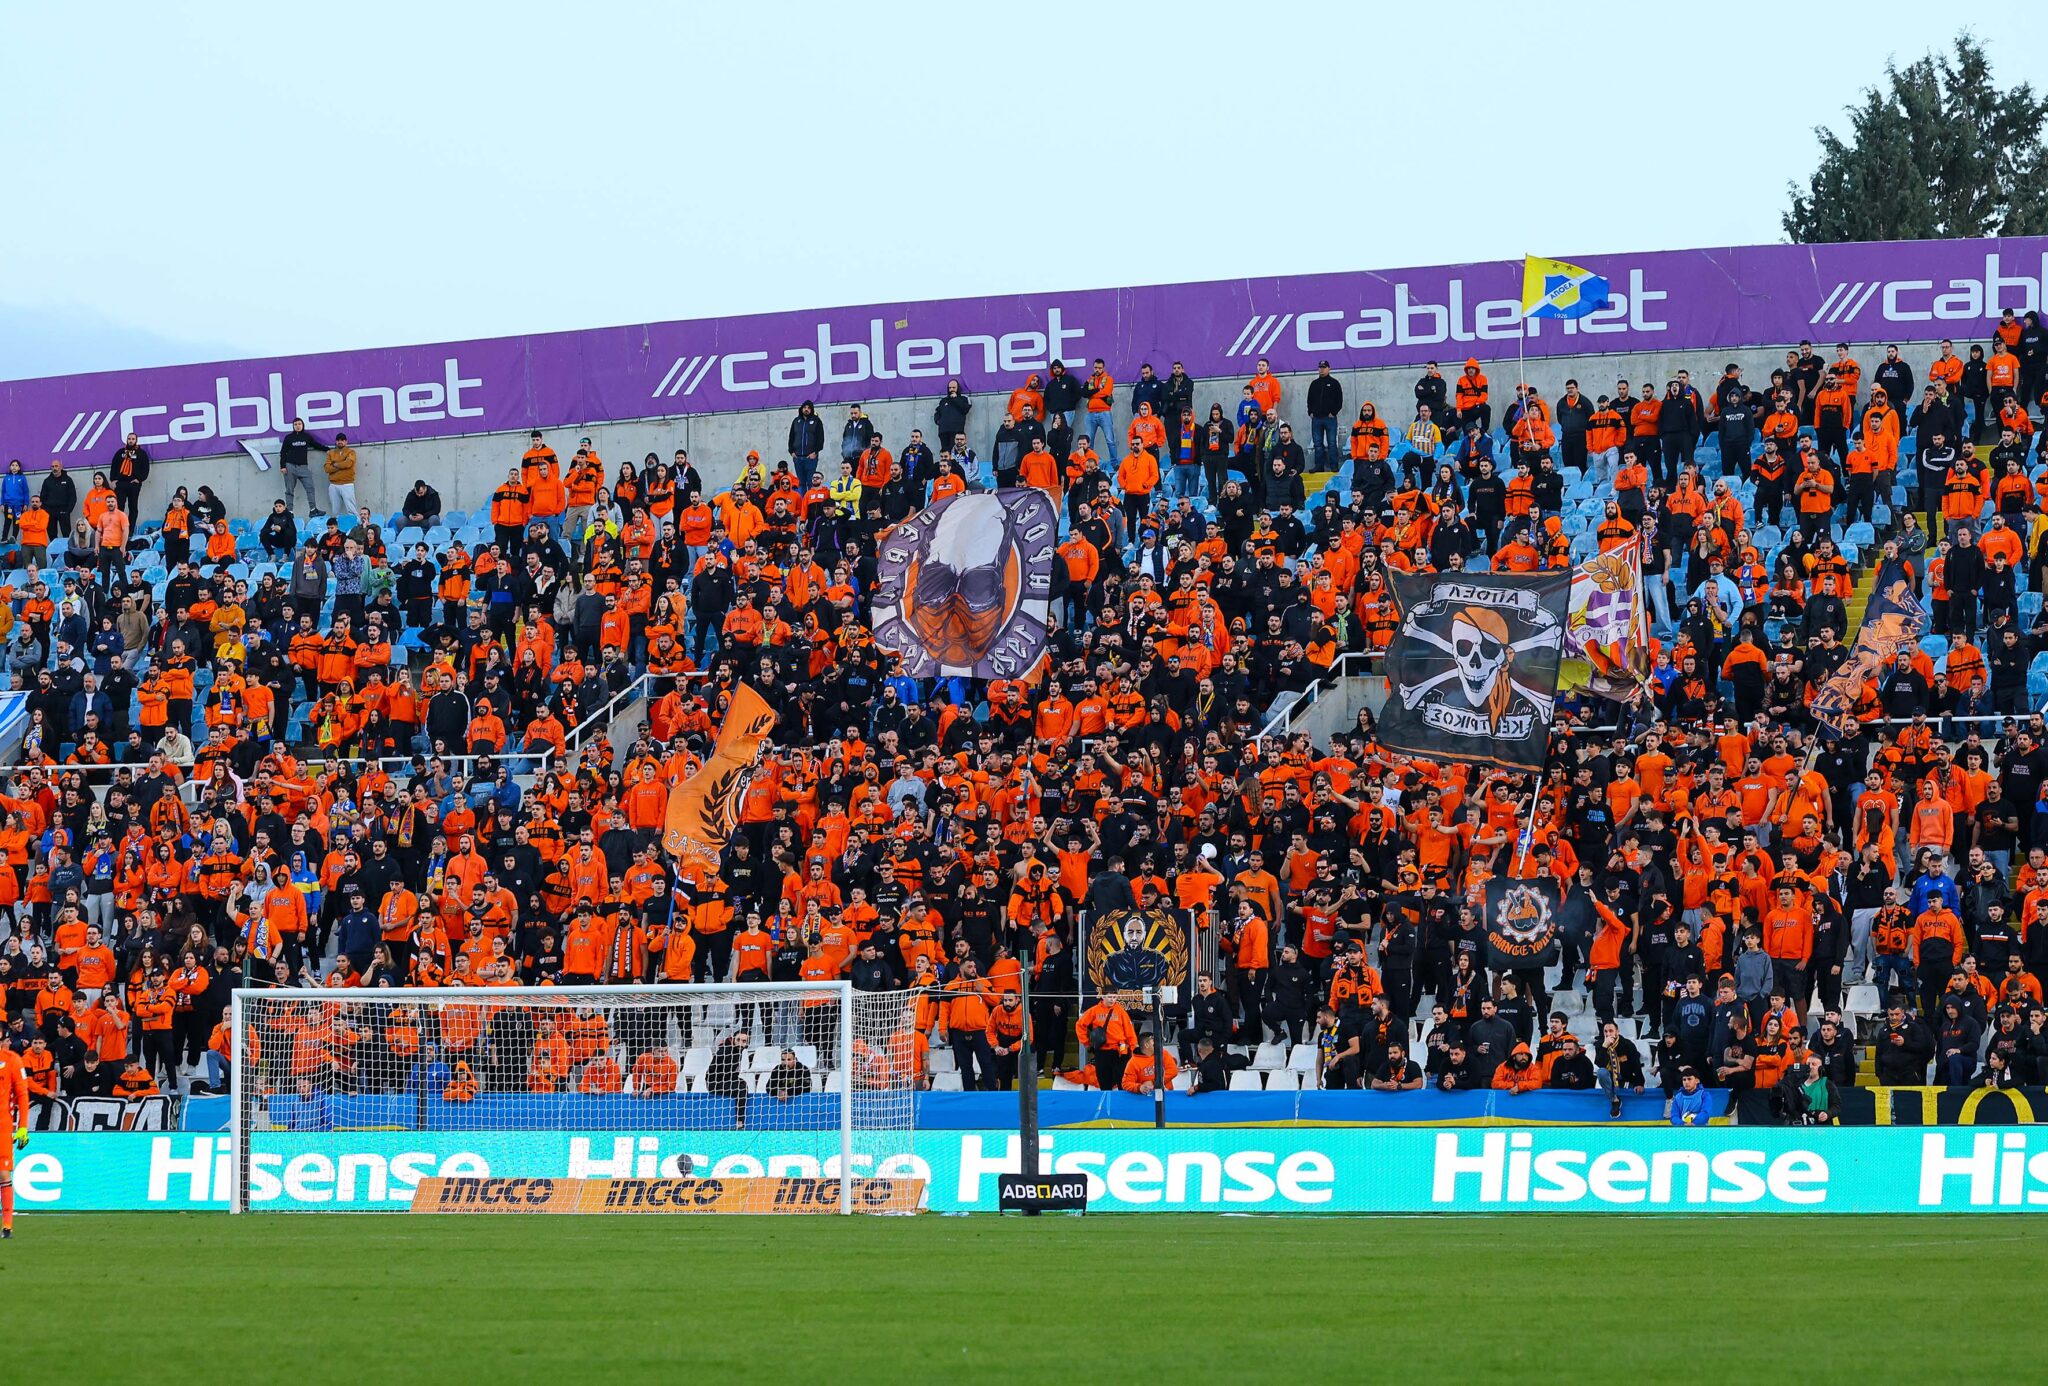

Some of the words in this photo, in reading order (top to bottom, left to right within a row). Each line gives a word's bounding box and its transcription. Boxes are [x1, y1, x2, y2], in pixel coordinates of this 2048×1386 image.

[1549, 281, 1574, 300] ΑΠΟΕΛ
[720, 307, 1087, 393] cablenet
[119, 357, 485, 446] cablenet
[1681, 1003, 1706, 1016] IOWA
[147, 1136, 491, 1203] Hisense
[1431, 1132, 1829, 1204] Hisense
